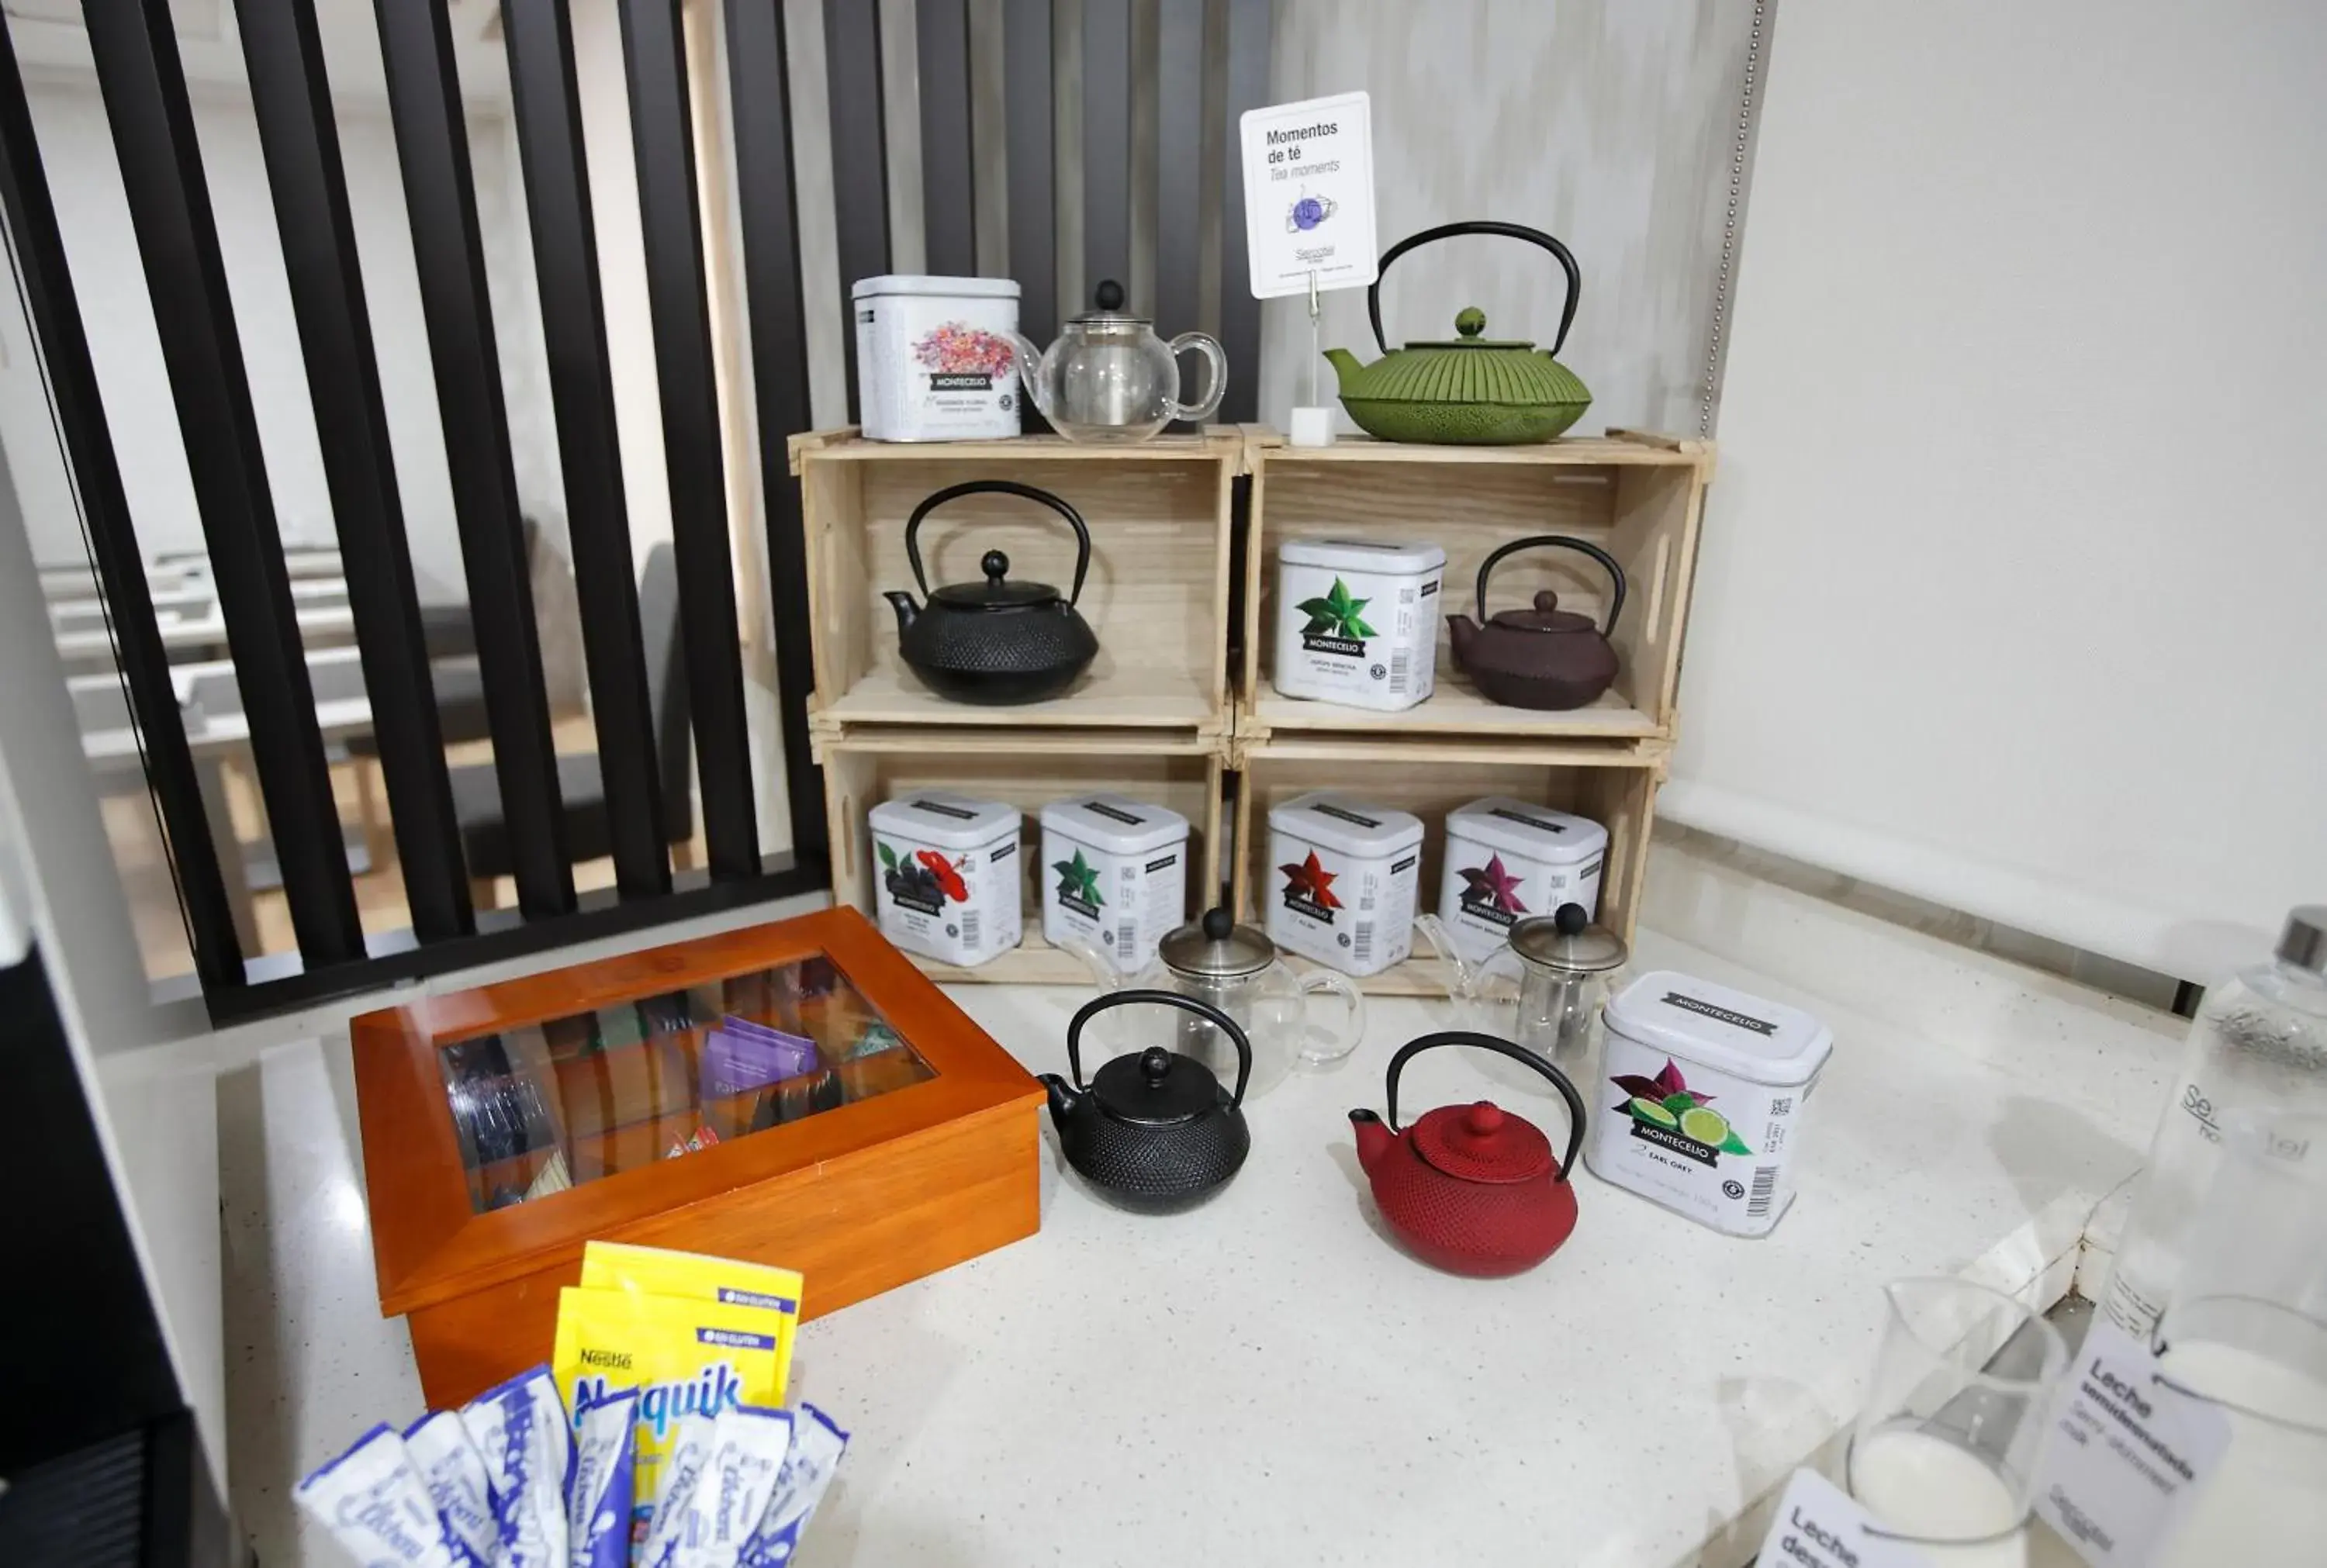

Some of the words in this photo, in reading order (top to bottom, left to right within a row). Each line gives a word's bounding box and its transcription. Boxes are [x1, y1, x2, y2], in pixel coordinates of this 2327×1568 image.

[1267, 123, 1338, 146] Momentos
[1268, 149, 1284, 164] de
[1288, 145, 1301, 161] té
[1271, 168, 1288, 181] Tea
[1291, 161, 1340, 178] moments
[1309, 638, 1358, 652] MONTECELIO
[1675, 998, 1762, 1029] MONTECELIO
[1649, 1152, 1668, 1165] EARL
[1670, 1160, 1693, 1173] GREY
[2089, 1357, 2152, 1419] Leche
[1791, 1505, 1859, 1568] Leche
